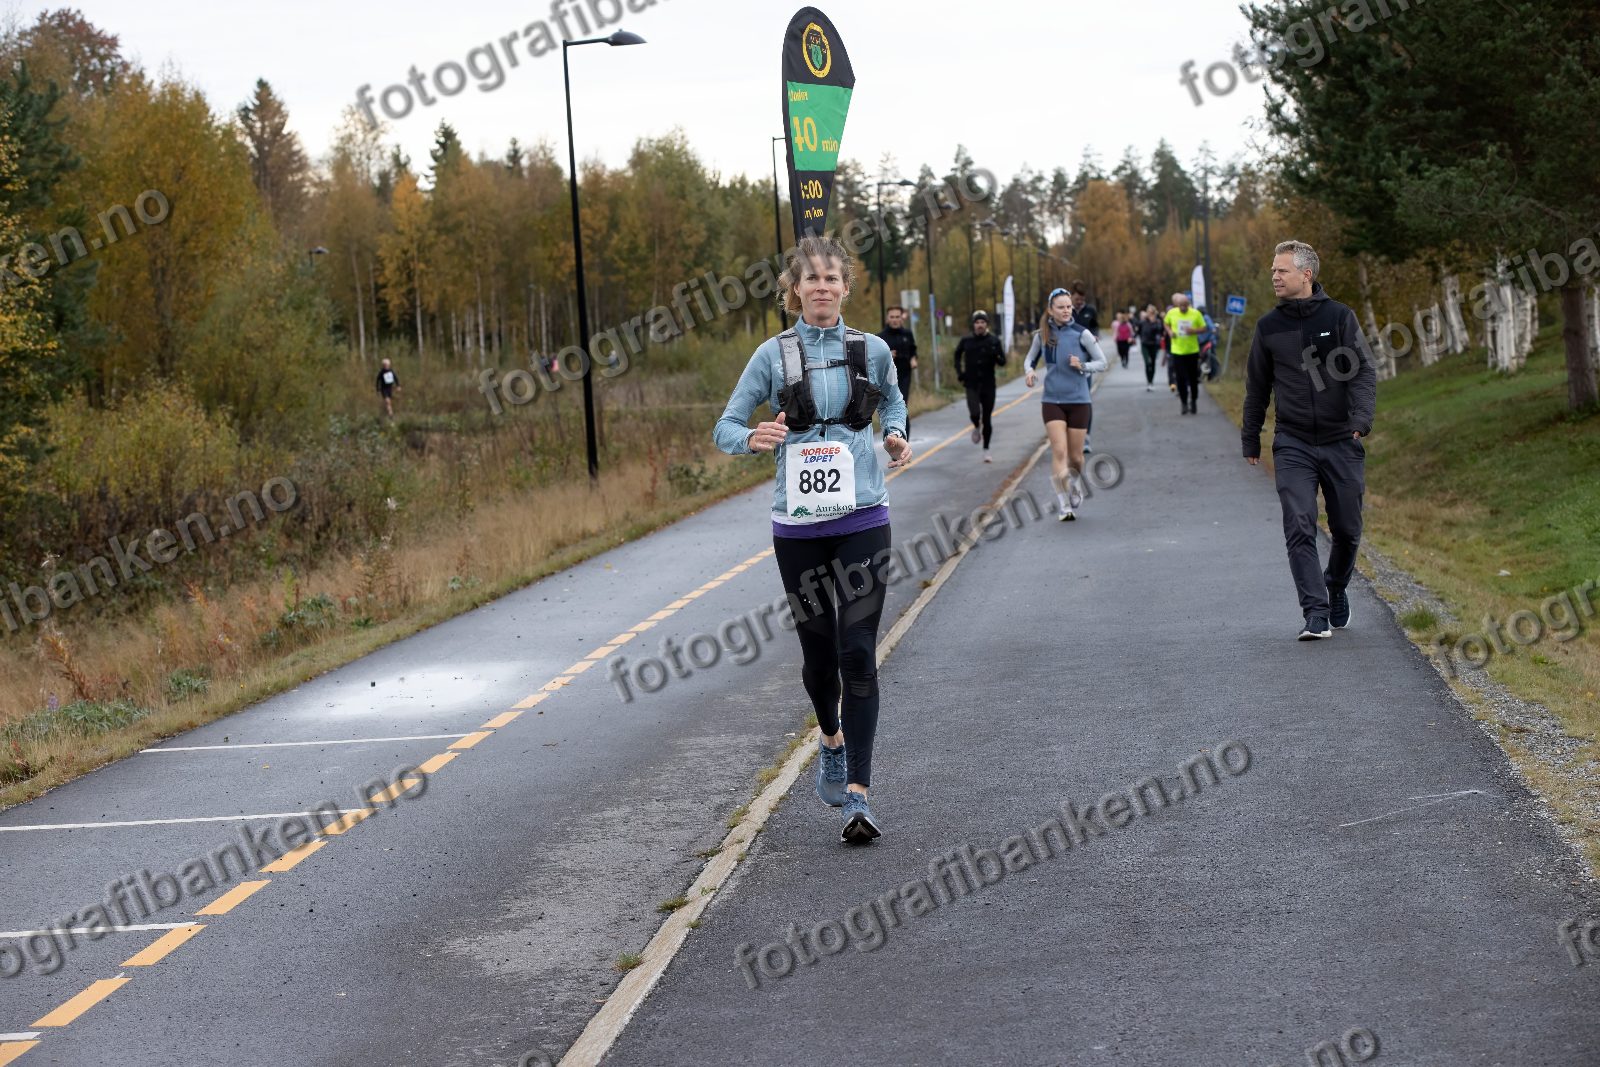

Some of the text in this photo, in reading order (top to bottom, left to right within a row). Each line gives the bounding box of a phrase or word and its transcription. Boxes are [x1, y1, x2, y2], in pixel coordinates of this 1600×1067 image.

[800, 447, 841, 456] NORGES
[804, 455, 834, 463] LØPET
[799, 468, 841, 494] 882
[816, 503, 854, 512] Aurskog
